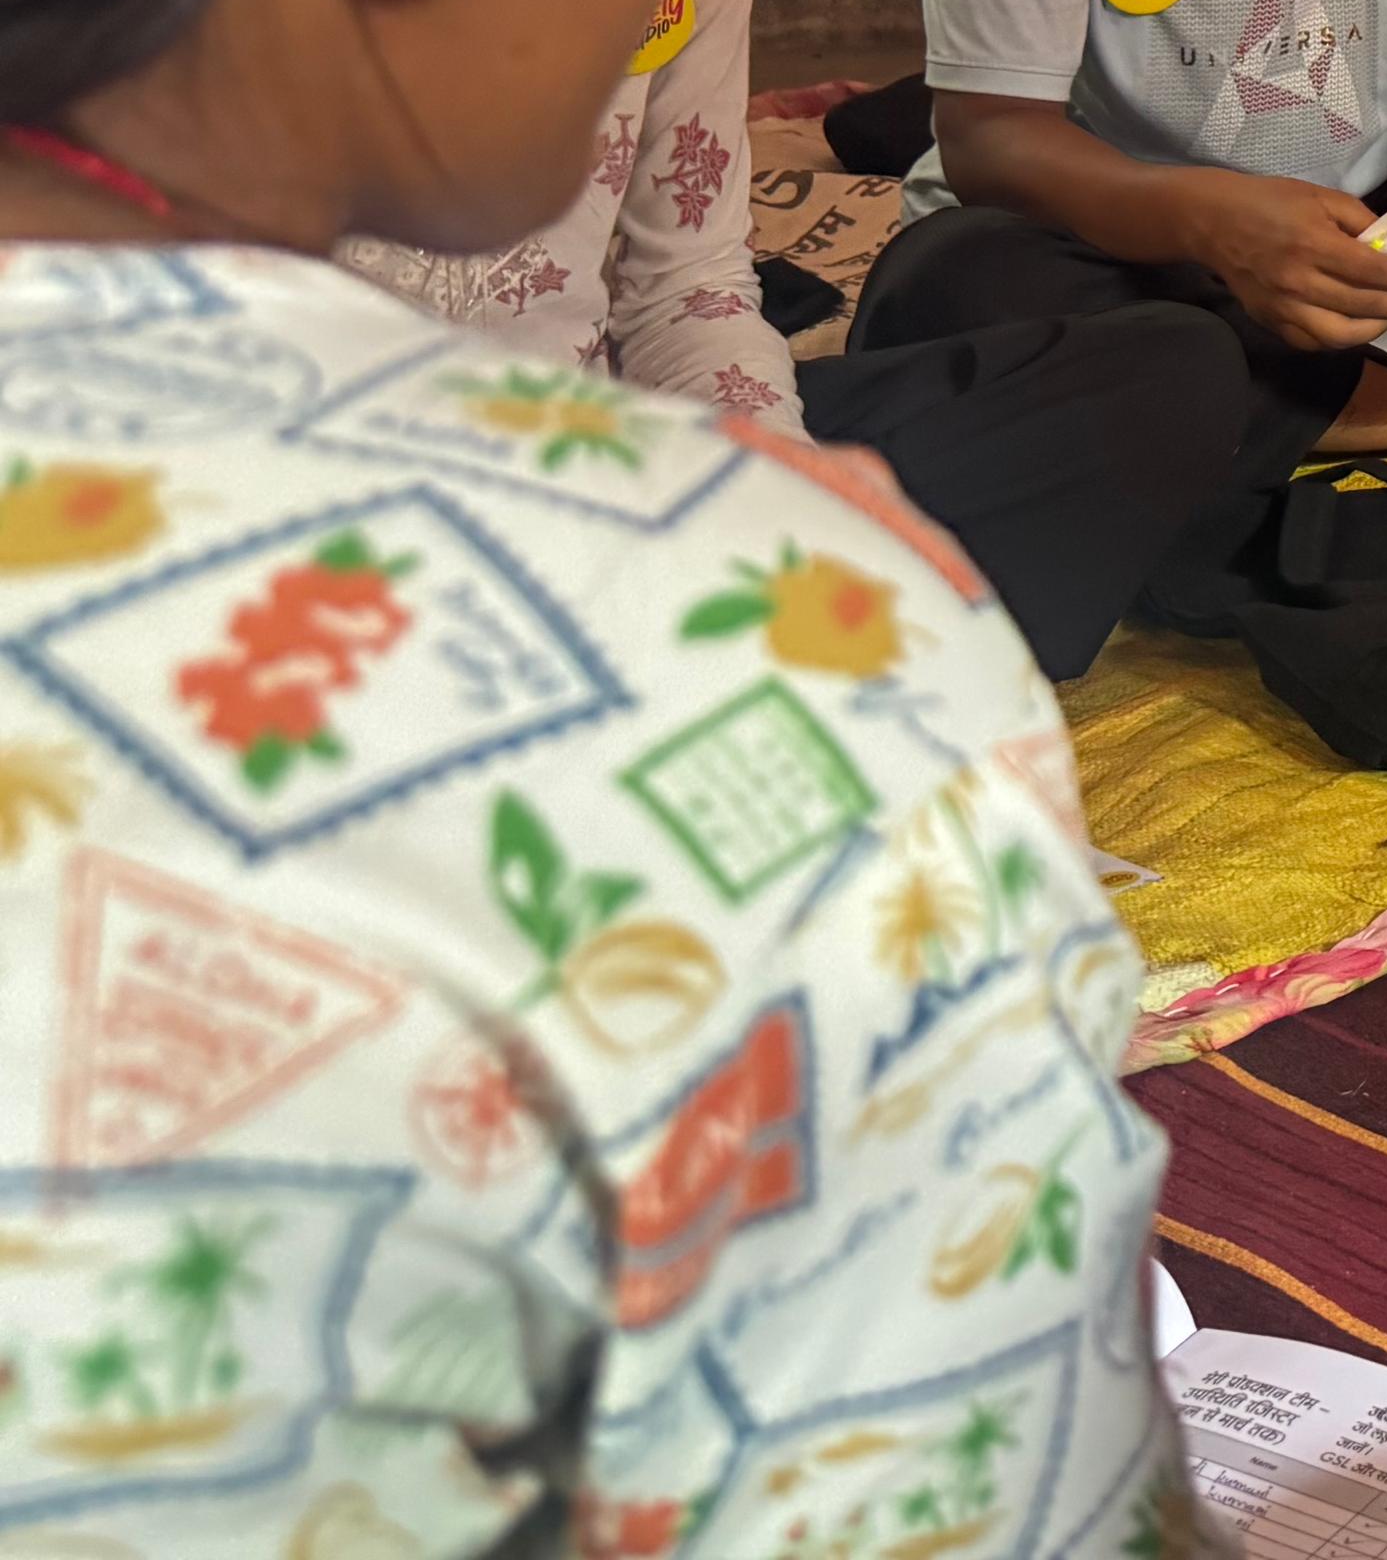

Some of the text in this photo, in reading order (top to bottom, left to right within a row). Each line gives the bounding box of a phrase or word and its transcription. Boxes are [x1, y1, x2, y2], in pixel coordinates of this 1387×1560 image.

[1202, 1370, 1228, 1385] मेरी
[1289, 1391, 1320, 1410] टीम
[1218, 1411, 1251, 1432] मार्च
[1246, 1400, 1301, 1426] रजिस्टर
[1250, 1456, 1279, 1471] Name
[1320, 1451, 1352, 1470] GSL
